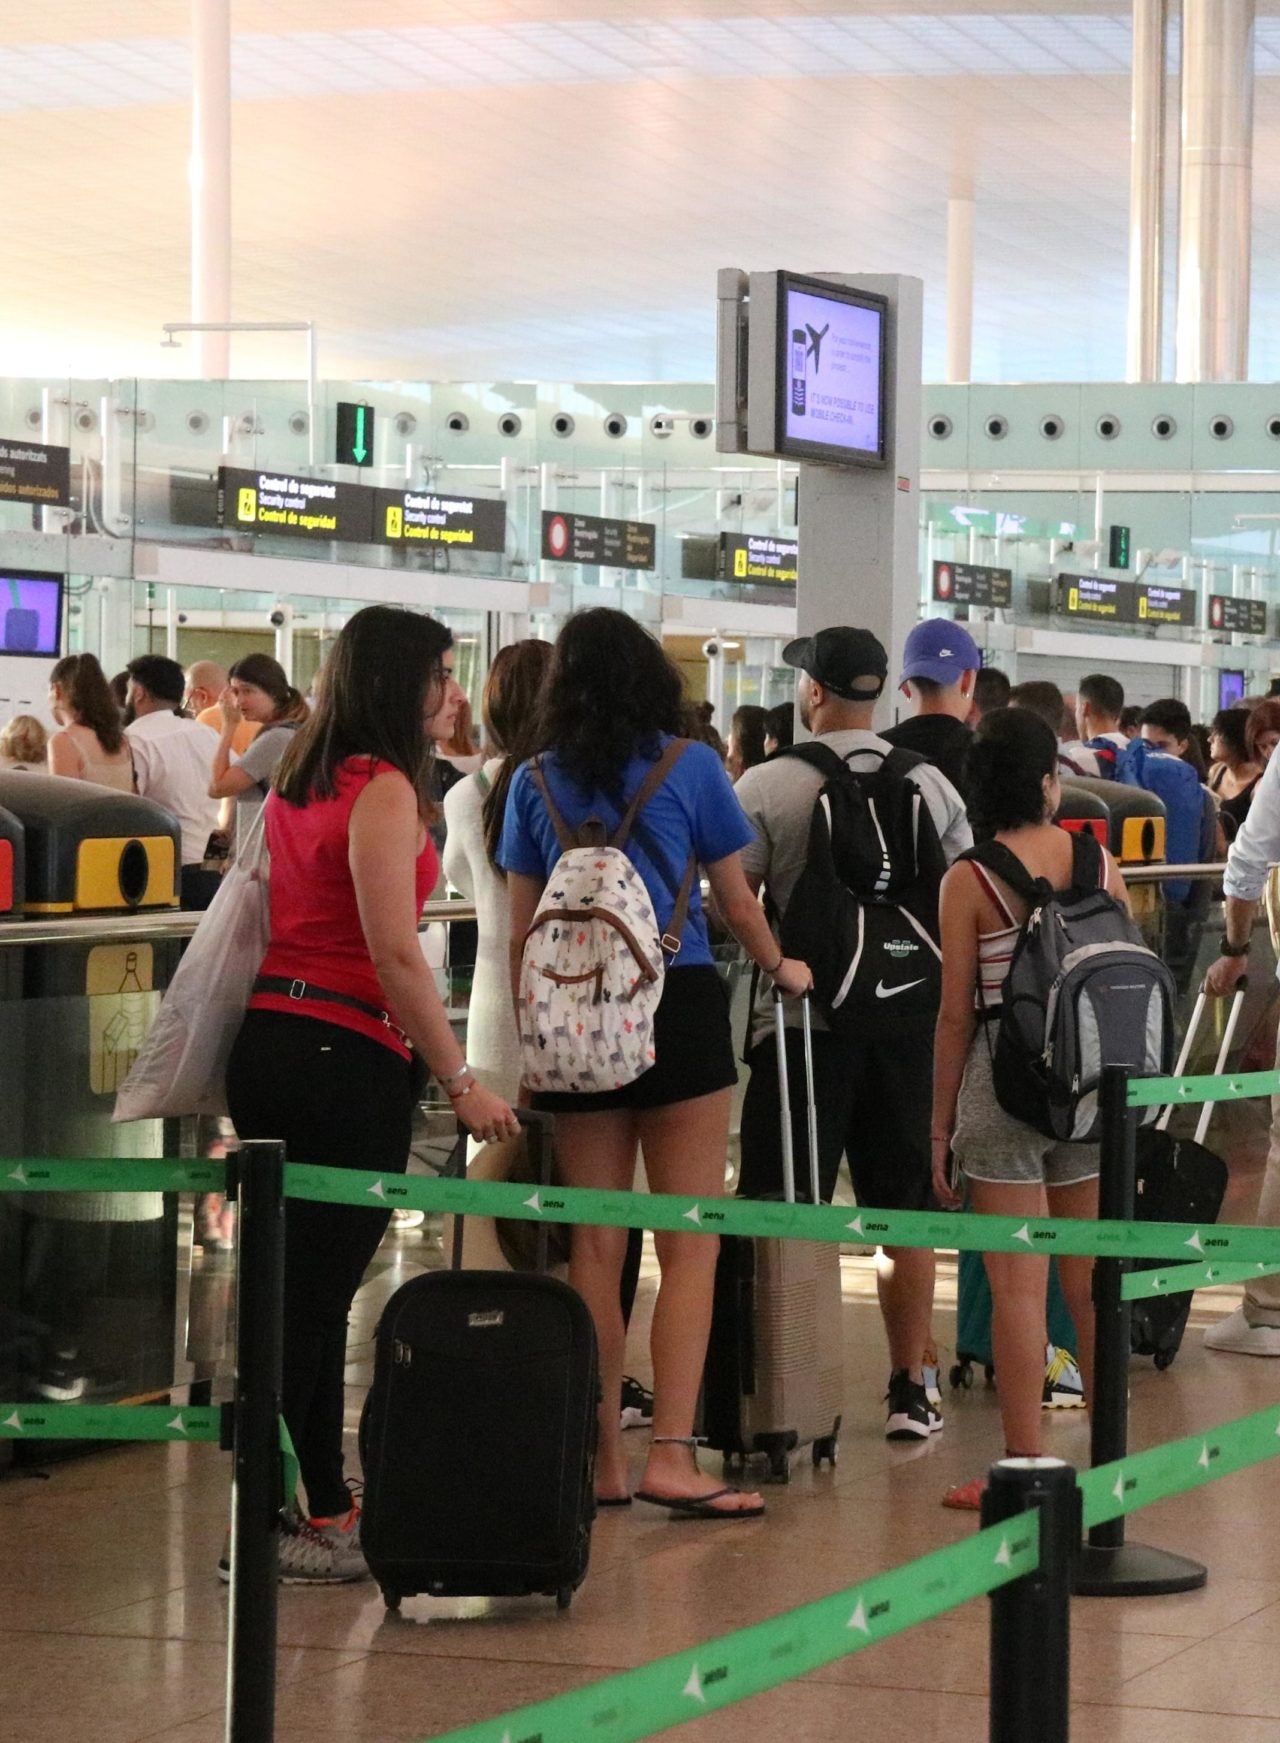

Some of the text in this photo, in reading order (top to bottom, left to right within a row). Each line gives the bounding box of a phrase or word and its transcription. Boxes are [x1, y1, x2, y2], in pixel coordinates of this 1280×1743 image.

[259, 475, 336, 498] Control de seguretat
[259, 492, 306, 509] Security control
[258, 508, 336, 529] Control de seguridad
[883, 942, 919, 951] Upstate
[387, 1186, 407, 1196] aena
[542, 1199, 564, 1209] aena
[703, 1211, 724, 1221] aena
[866, 1222, 889, 1232] aena
[1033, 1230, 1056, 1240] aena
[1204, 1238, 1229, 1247] aena
